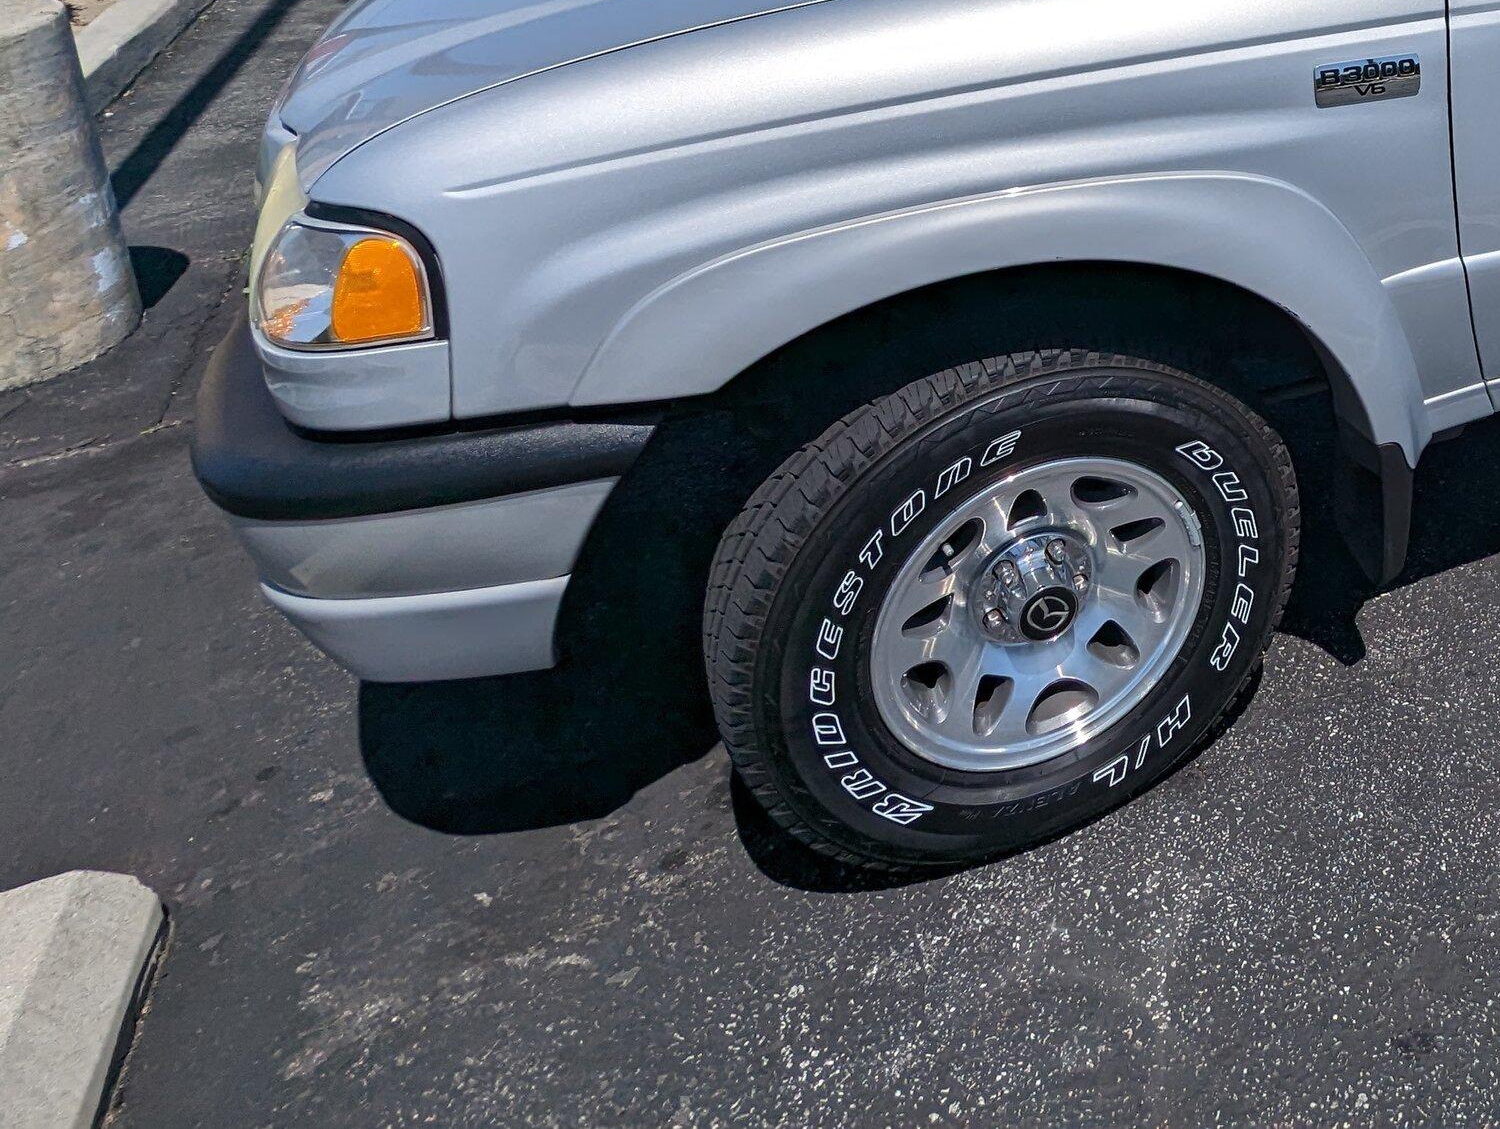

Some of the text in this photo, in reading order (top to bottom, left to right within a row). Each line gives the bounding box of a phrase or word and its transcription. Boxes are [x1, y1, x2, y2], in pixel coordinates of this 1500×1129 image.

[1320, 58, 1417, 87] B3000
[1354, 82, 1387, 97] V6
[809, 428, 1022, 826] BRIDGESTONE
[1093, 439, 1260, 789] DUELER H/L
